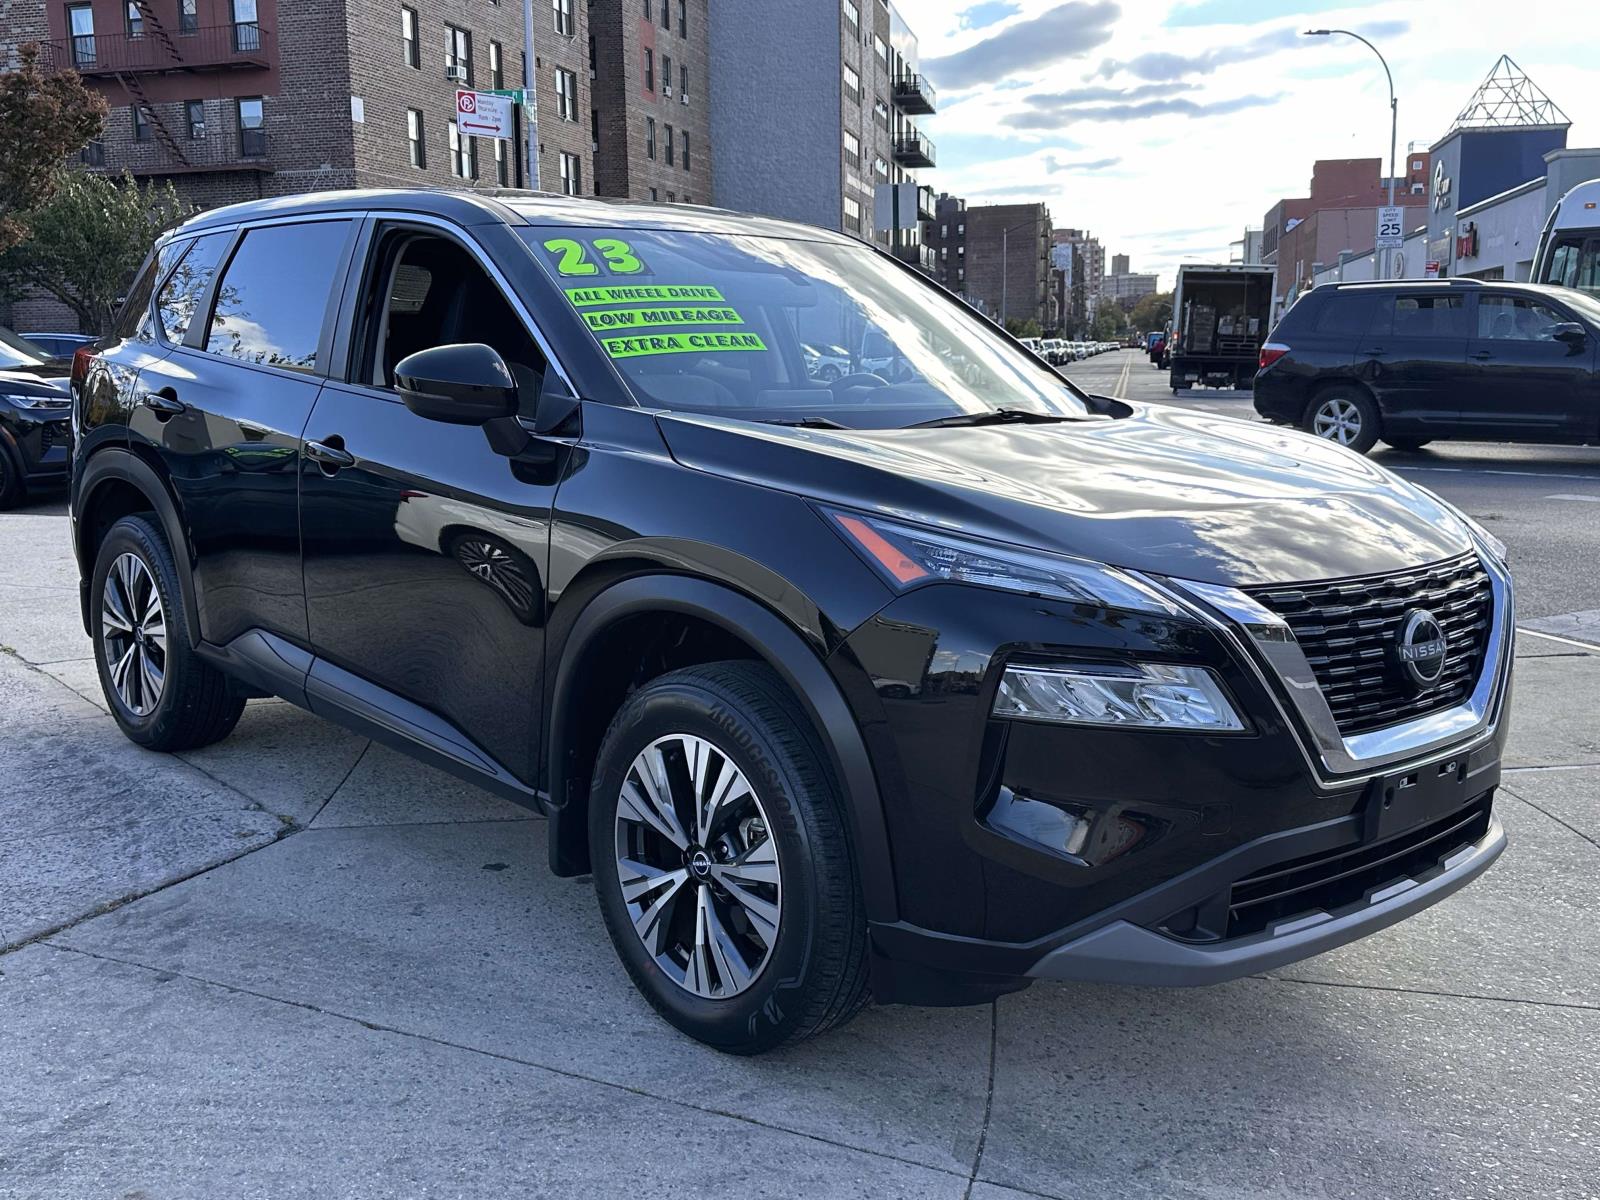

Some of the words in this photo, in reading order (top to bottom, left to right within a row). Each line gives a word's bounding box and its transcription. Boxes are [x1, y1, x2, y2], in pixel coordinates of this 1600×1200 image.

[1380, 223, 1401, 235] 25
[543, 238, 642, 276] 23
[573, 288, 605, 303] ALL
[605, 287, 666, 301] WHEEL
[667, 287, 720, 299] DRIVE
[587, 311, 635, 328] LOW
[642, 309, 737, 323] MILEAGE
[607, 336, 684, 354] EXTRA
[688, 334, 759, 348] CLEAN
[1402, 639, 1447, 660] NISSAN
[707, 702, 804, 848] BRIDGESTONE
